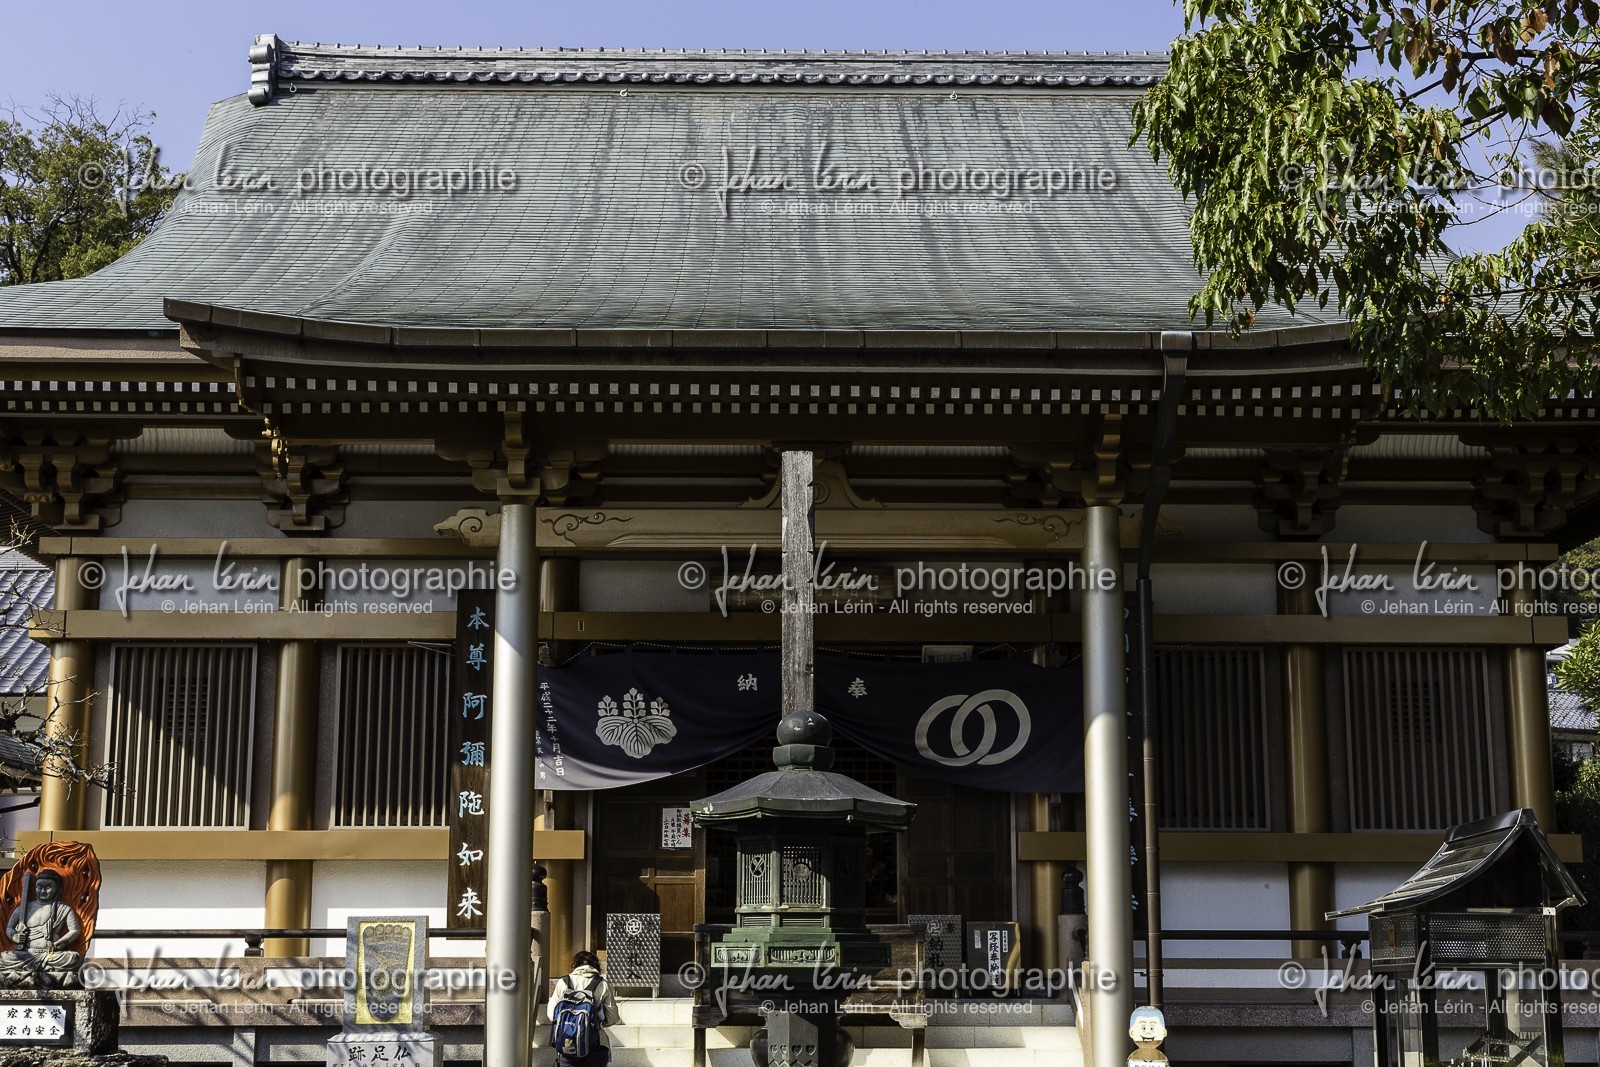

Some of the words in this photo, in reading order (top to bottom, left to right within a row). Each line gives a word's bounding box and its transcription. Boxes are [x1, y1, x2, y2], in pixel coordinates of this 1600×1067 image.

[737, 673, 758, 691] 納
[927, 936, 945, 981] 納札
[7, 1007, 62, 1020] 家業繁栄
[6, 1024, 60, 1036] 家内安全
